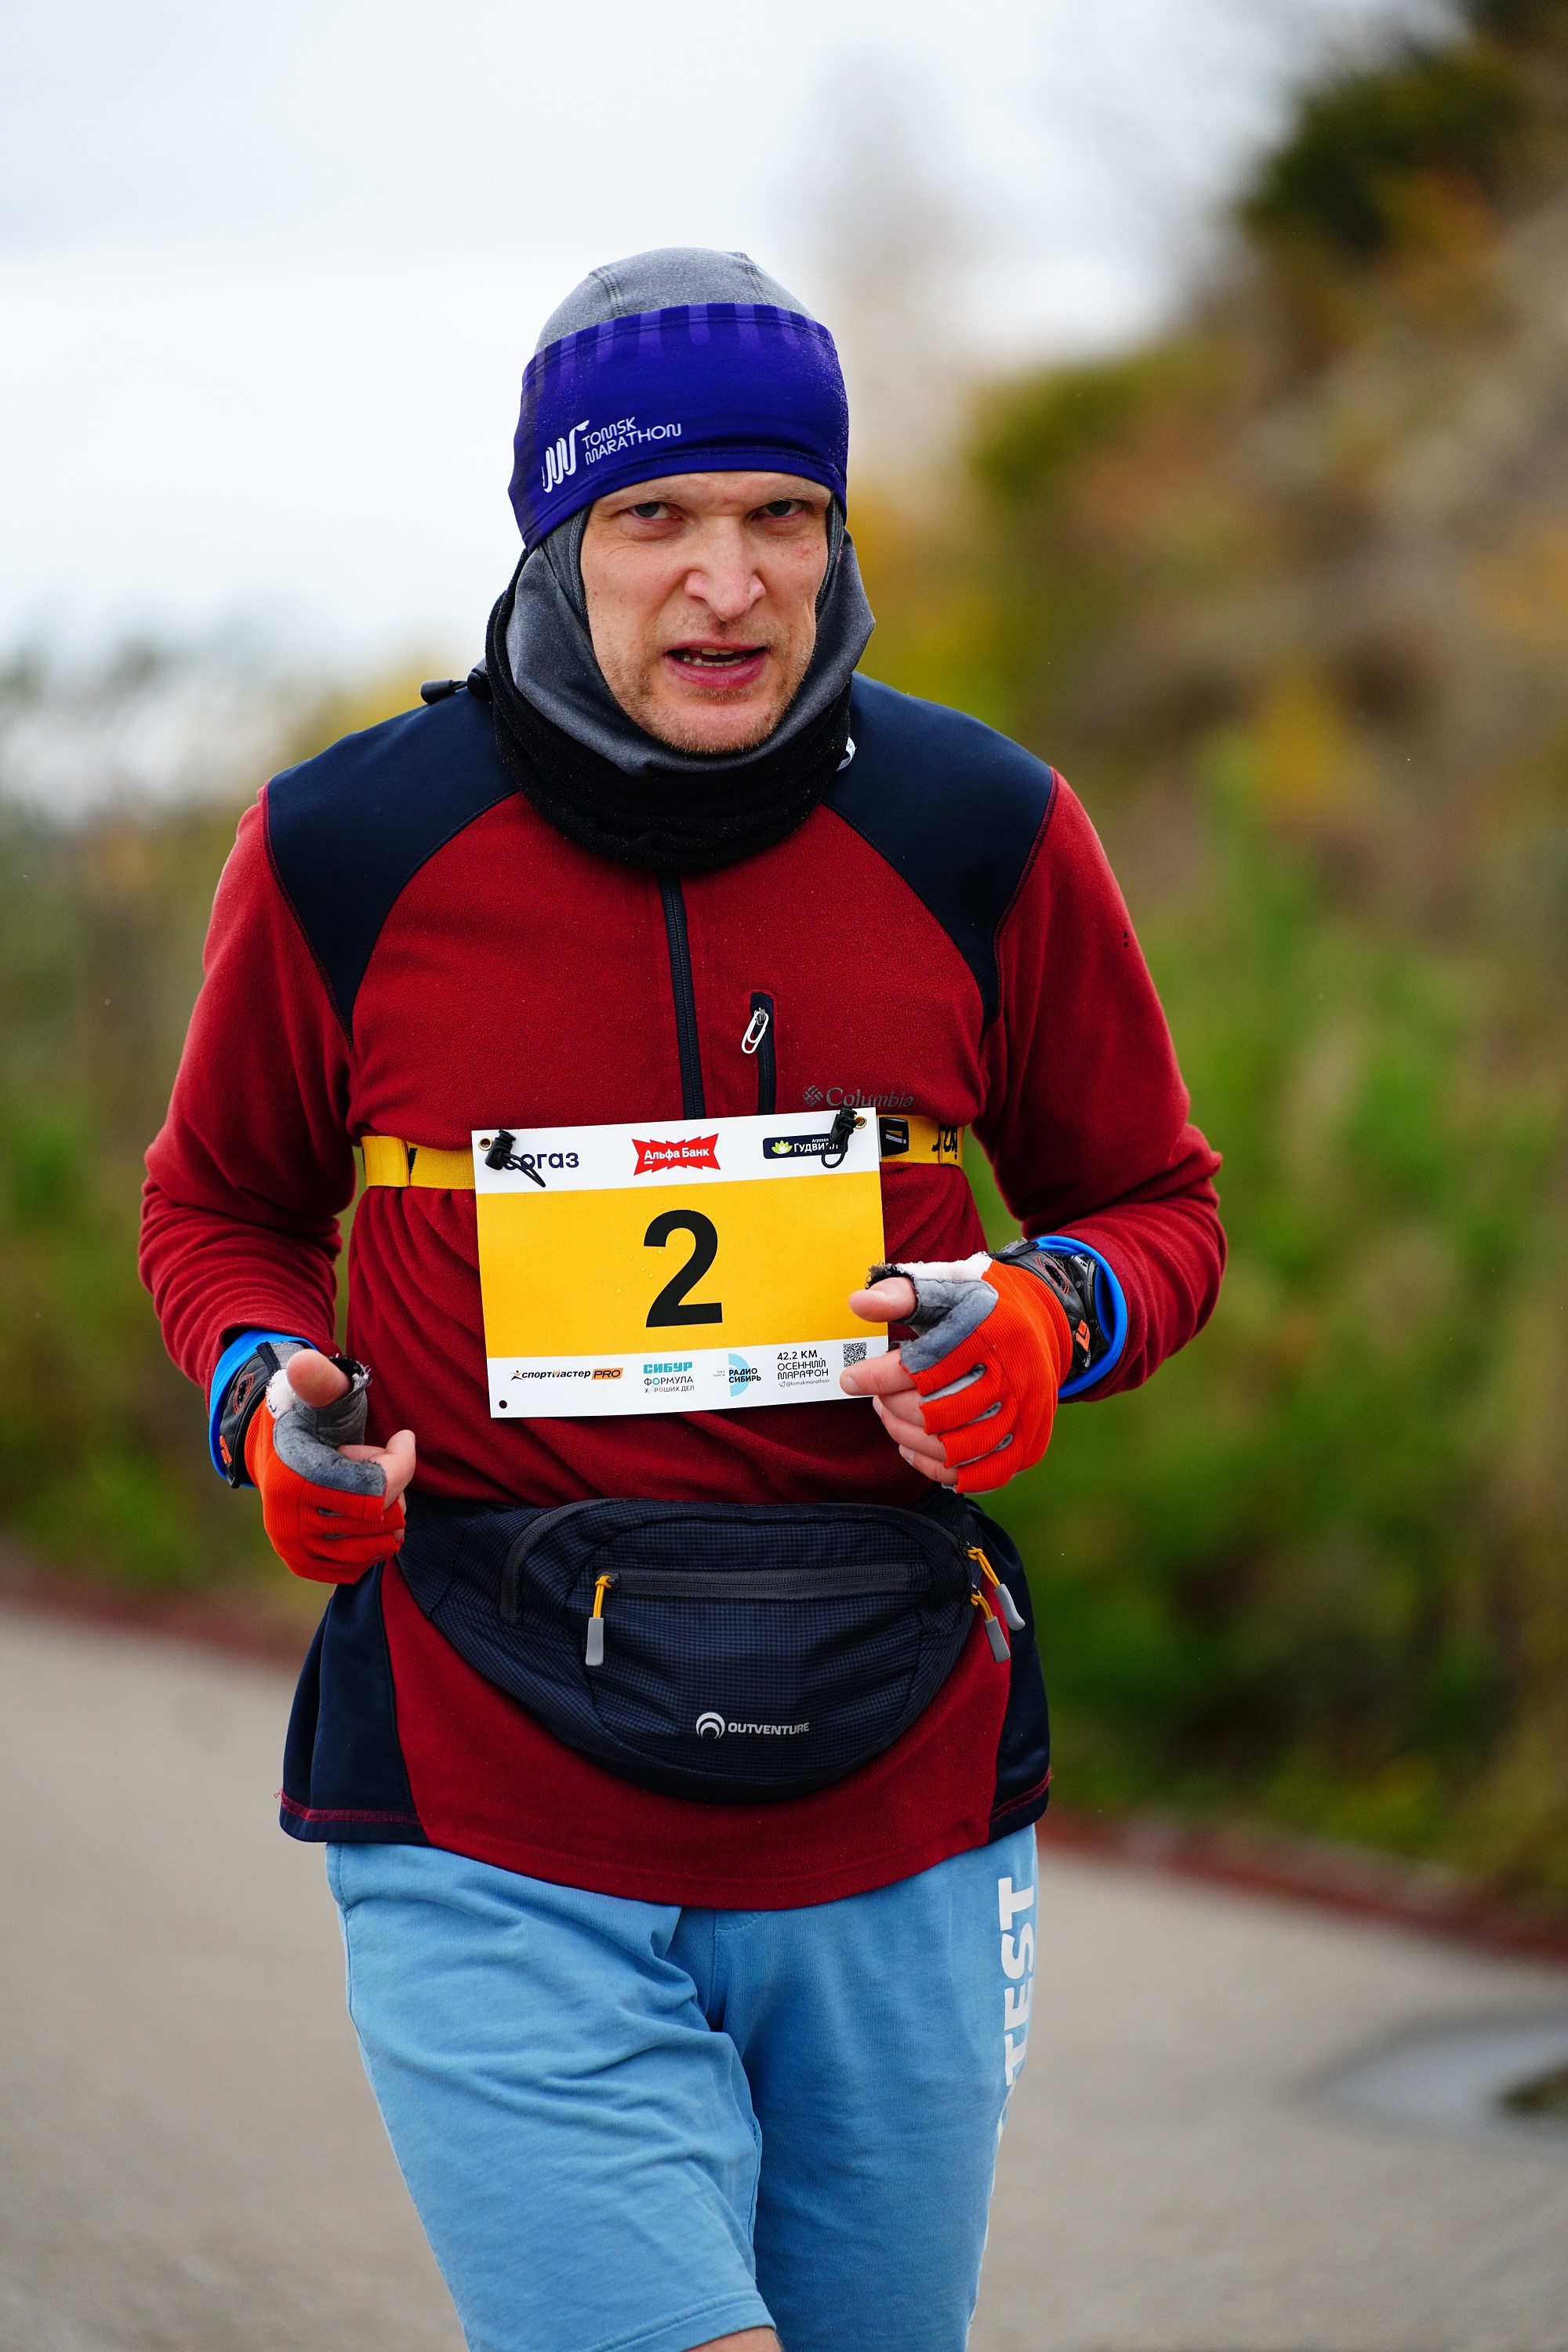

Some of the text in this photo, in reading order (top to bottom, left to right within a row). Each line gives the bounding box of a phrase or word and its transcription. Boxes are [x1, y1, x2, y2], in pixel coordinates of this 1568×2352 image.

[582, 416, 637, 449] TOMSK
[585, 423, 681, 465] MARATHON
[826, 1087, 913, 1108] Columbia
[644, 1147, 710, 1162] Альфа Банк
[644, 1209, 723, 1328] 2
[777, 1351, 798, 1360] 42.2
[644, 1362, 692, 1374] СИБУР
[777, 1357, 826, 1371] ОСЕННИЙ
[593, 1370, 621, 1378] PRO
[728, 1367, 758, 1377] РАДИО
[777, 1368, 829, 1381] МАРАФОН
[644, 1376, 693, 1386] ФОРМУЛА
[728, 1374, 762, 1384] СИБИРЬ
[728, 1722, 810, 1736] OUTVENTURE
